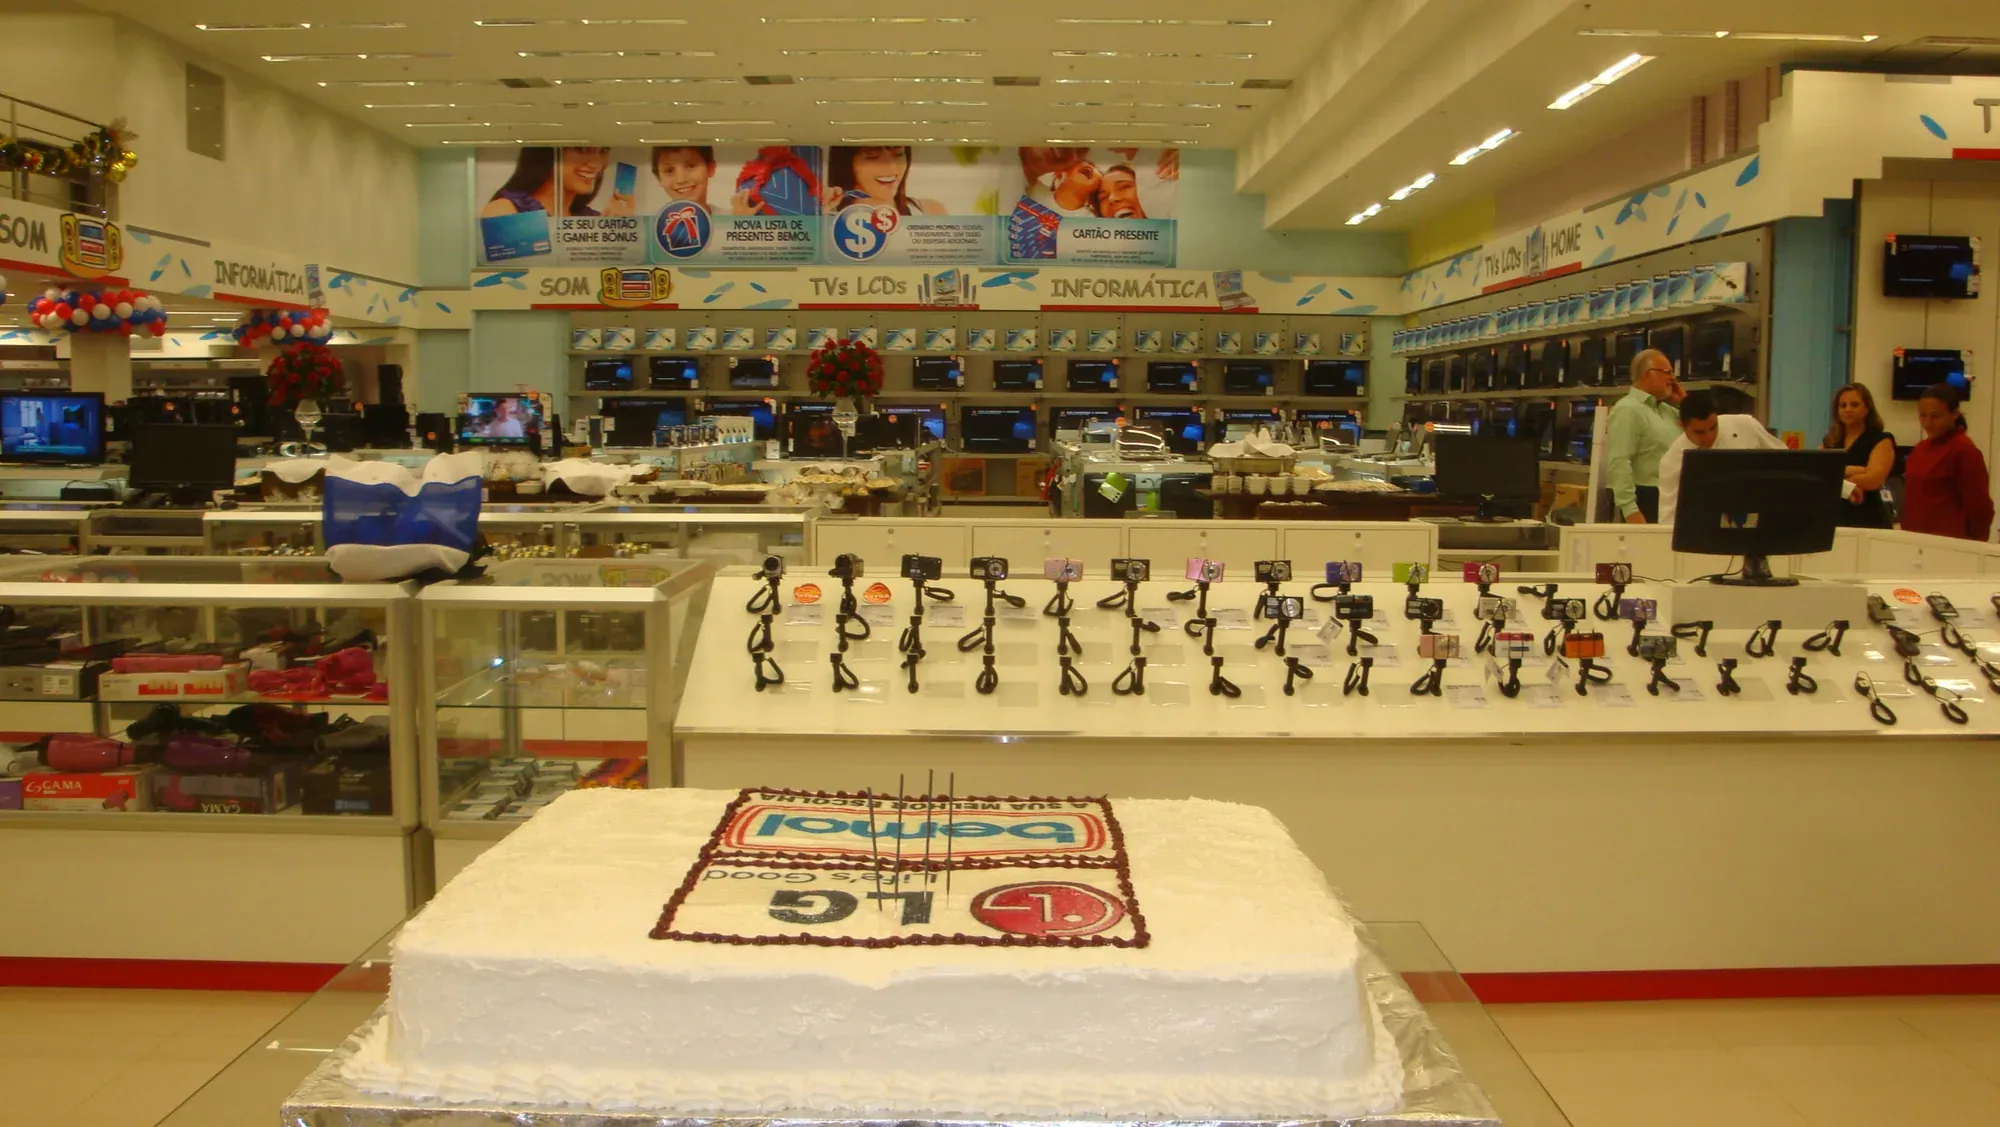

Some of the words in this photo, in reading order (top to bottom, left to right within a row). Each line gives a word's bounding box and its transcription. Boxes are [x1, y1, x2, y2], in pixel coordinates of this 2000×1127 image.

[576, 219, 595, 229] SEU
[597, 216, 638, 229] CARTÃO
[734, 220, 762, 230] NOVA
[765, 220, 788, 230] LISTA
[790, 220, 804, 230] DE
[0, 213, 48, 254] SOM
[562, 232, 599, 243] GANHE
[602, 229, 638, 242] BÔNUS
[726, 231, 775, 241] PRESENTES
[777, 231, 811, 241] BEMOL
[1072, 226, 1111, 239] CARTÃO
[1114, 230, 1160, 241] PRESENTE
[1484, 252, 1500, 279] TVs
[1501, 245, 1522, 274] LCDs
[1550, 222, 1582, 259] HOME
[214, 260, 304, 295] INFORMÁTICA
[1050, 272, 1208, 298] INFORMÁTICA
[539, 276, 591, 297] SOM
[808, 276, 849, 296] TVs
[856, 275, 908, 296] LCDs
[42, 780, 82, 790] GAMA
[891, 802, 1000, 810] MELHOR
[1009, 802, 1064, 810] SUA
[757, 813, 1076, 843] bemol
[702, 869, 817, 884] Good
[832, 872, 938, 885] Life's
[768, 889, 934, 926] LG
